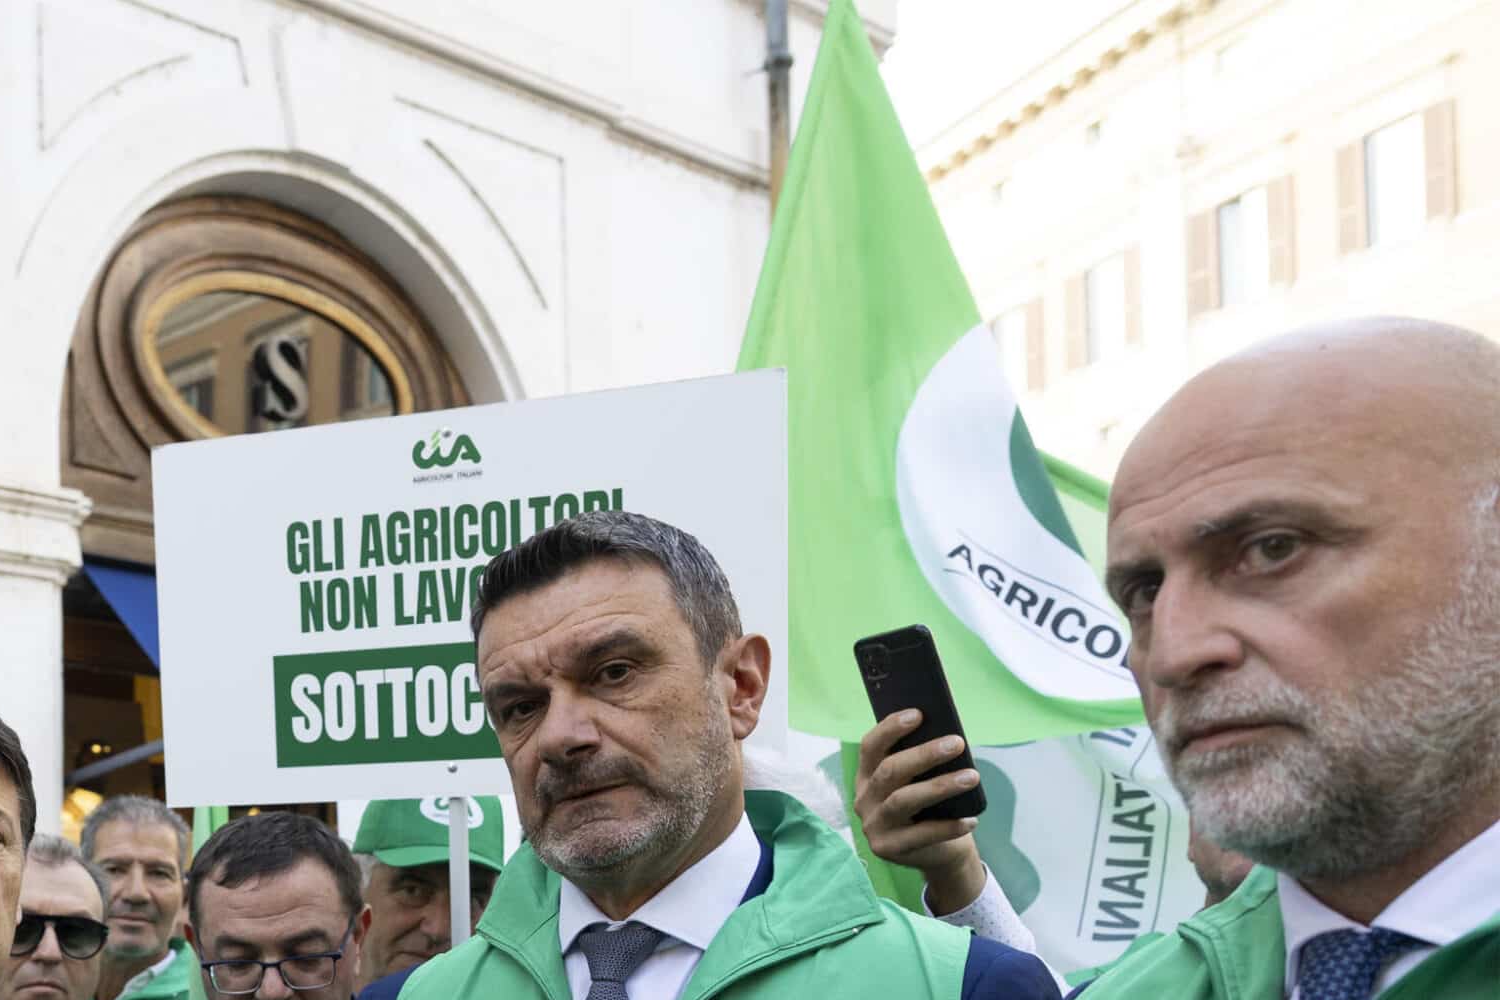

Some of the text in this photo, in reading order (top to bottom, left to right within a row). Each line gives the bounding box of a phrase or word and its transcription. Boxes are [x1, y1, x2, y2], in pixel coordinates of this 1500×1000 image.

[286, 517, 344, 575] GLI
[300, 574, 378, 634] NON
[947, 543, 1132, 669] AGRICO
[290, 662, 497, 744] SOTTOC
